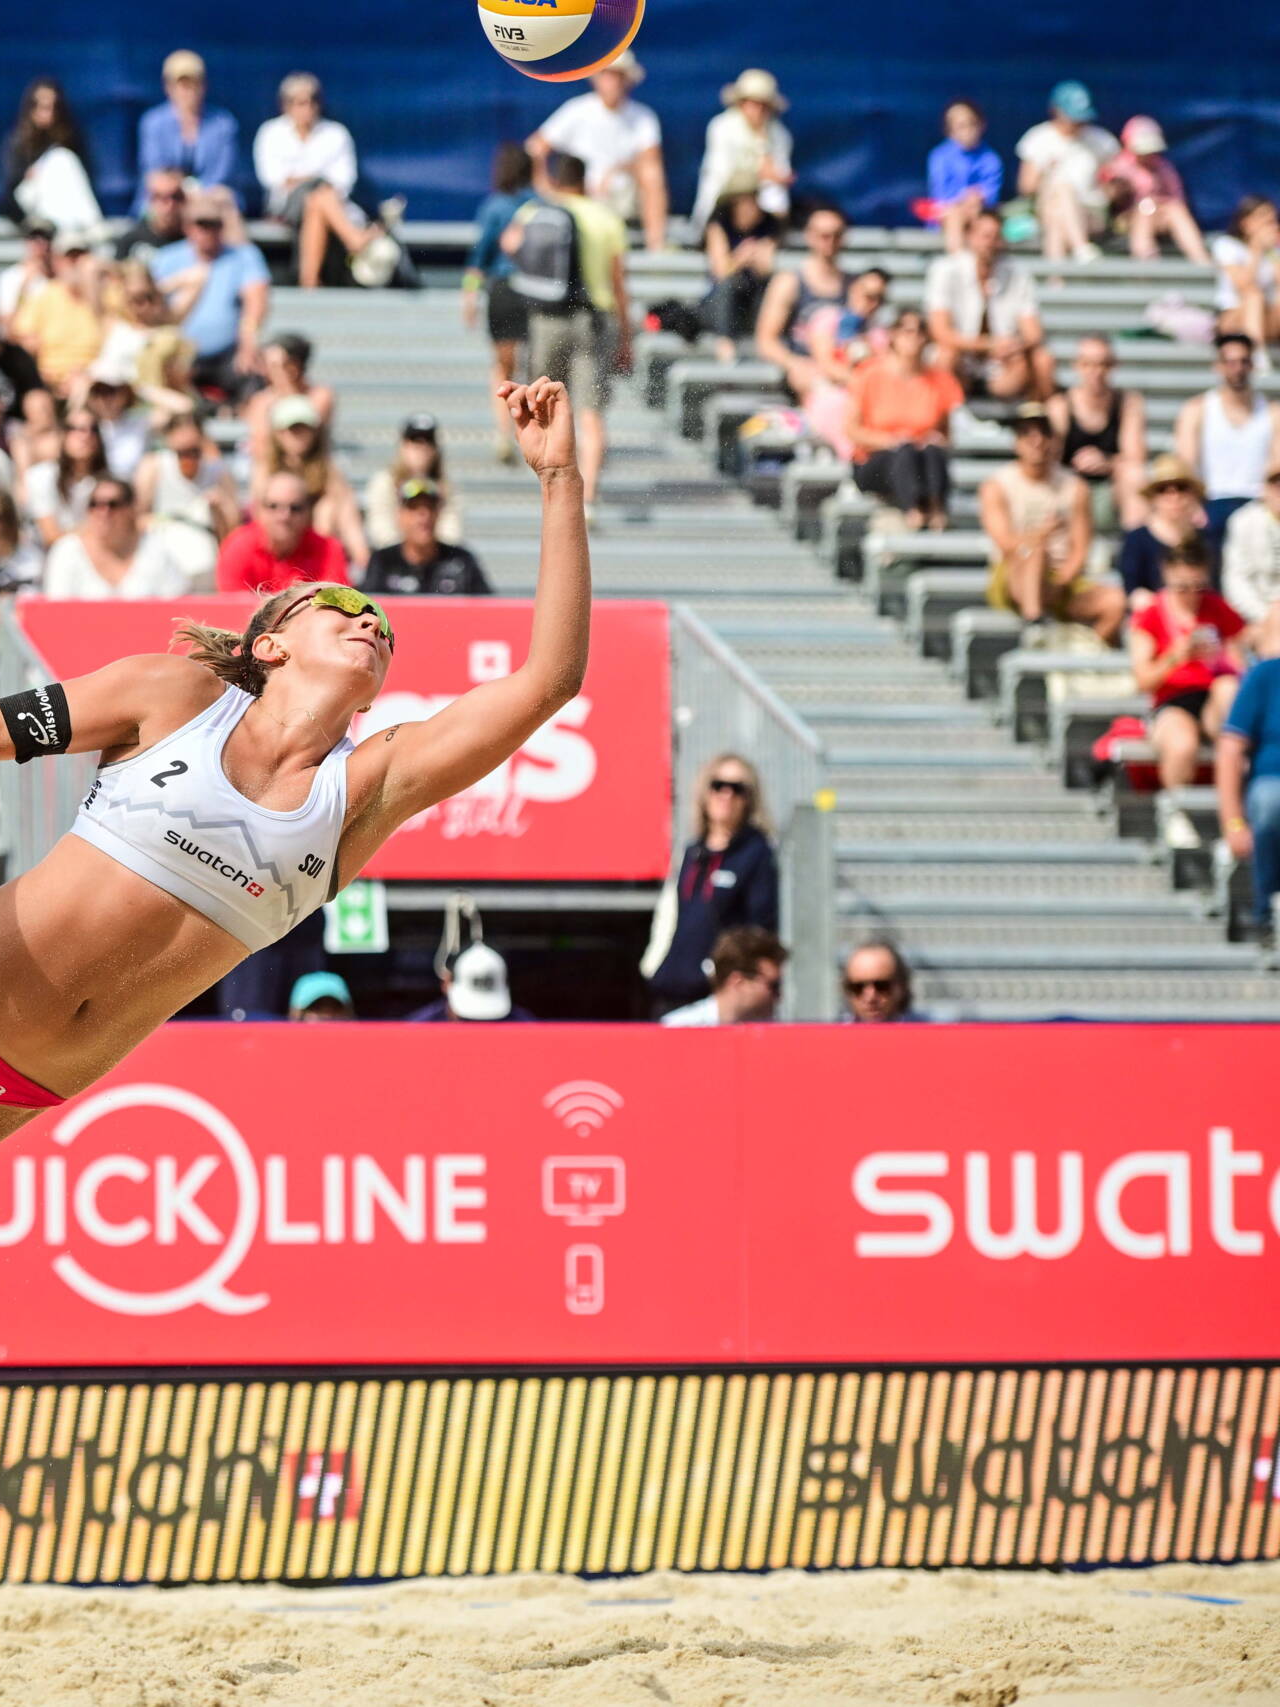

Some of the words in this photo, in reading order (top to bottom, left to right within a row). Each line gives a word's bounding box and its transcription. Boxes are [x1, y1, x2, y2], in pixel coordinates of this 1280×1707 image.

[150, 760, 189, 788] 2
[163, 829, 254, 888] swatch
[297, 853, 326, 880] SUI
[568, 1174, 602, 1200] TV
[851, 1126, 1280, 1260] swat
[797, 1418, 1236, 1508] swatch
